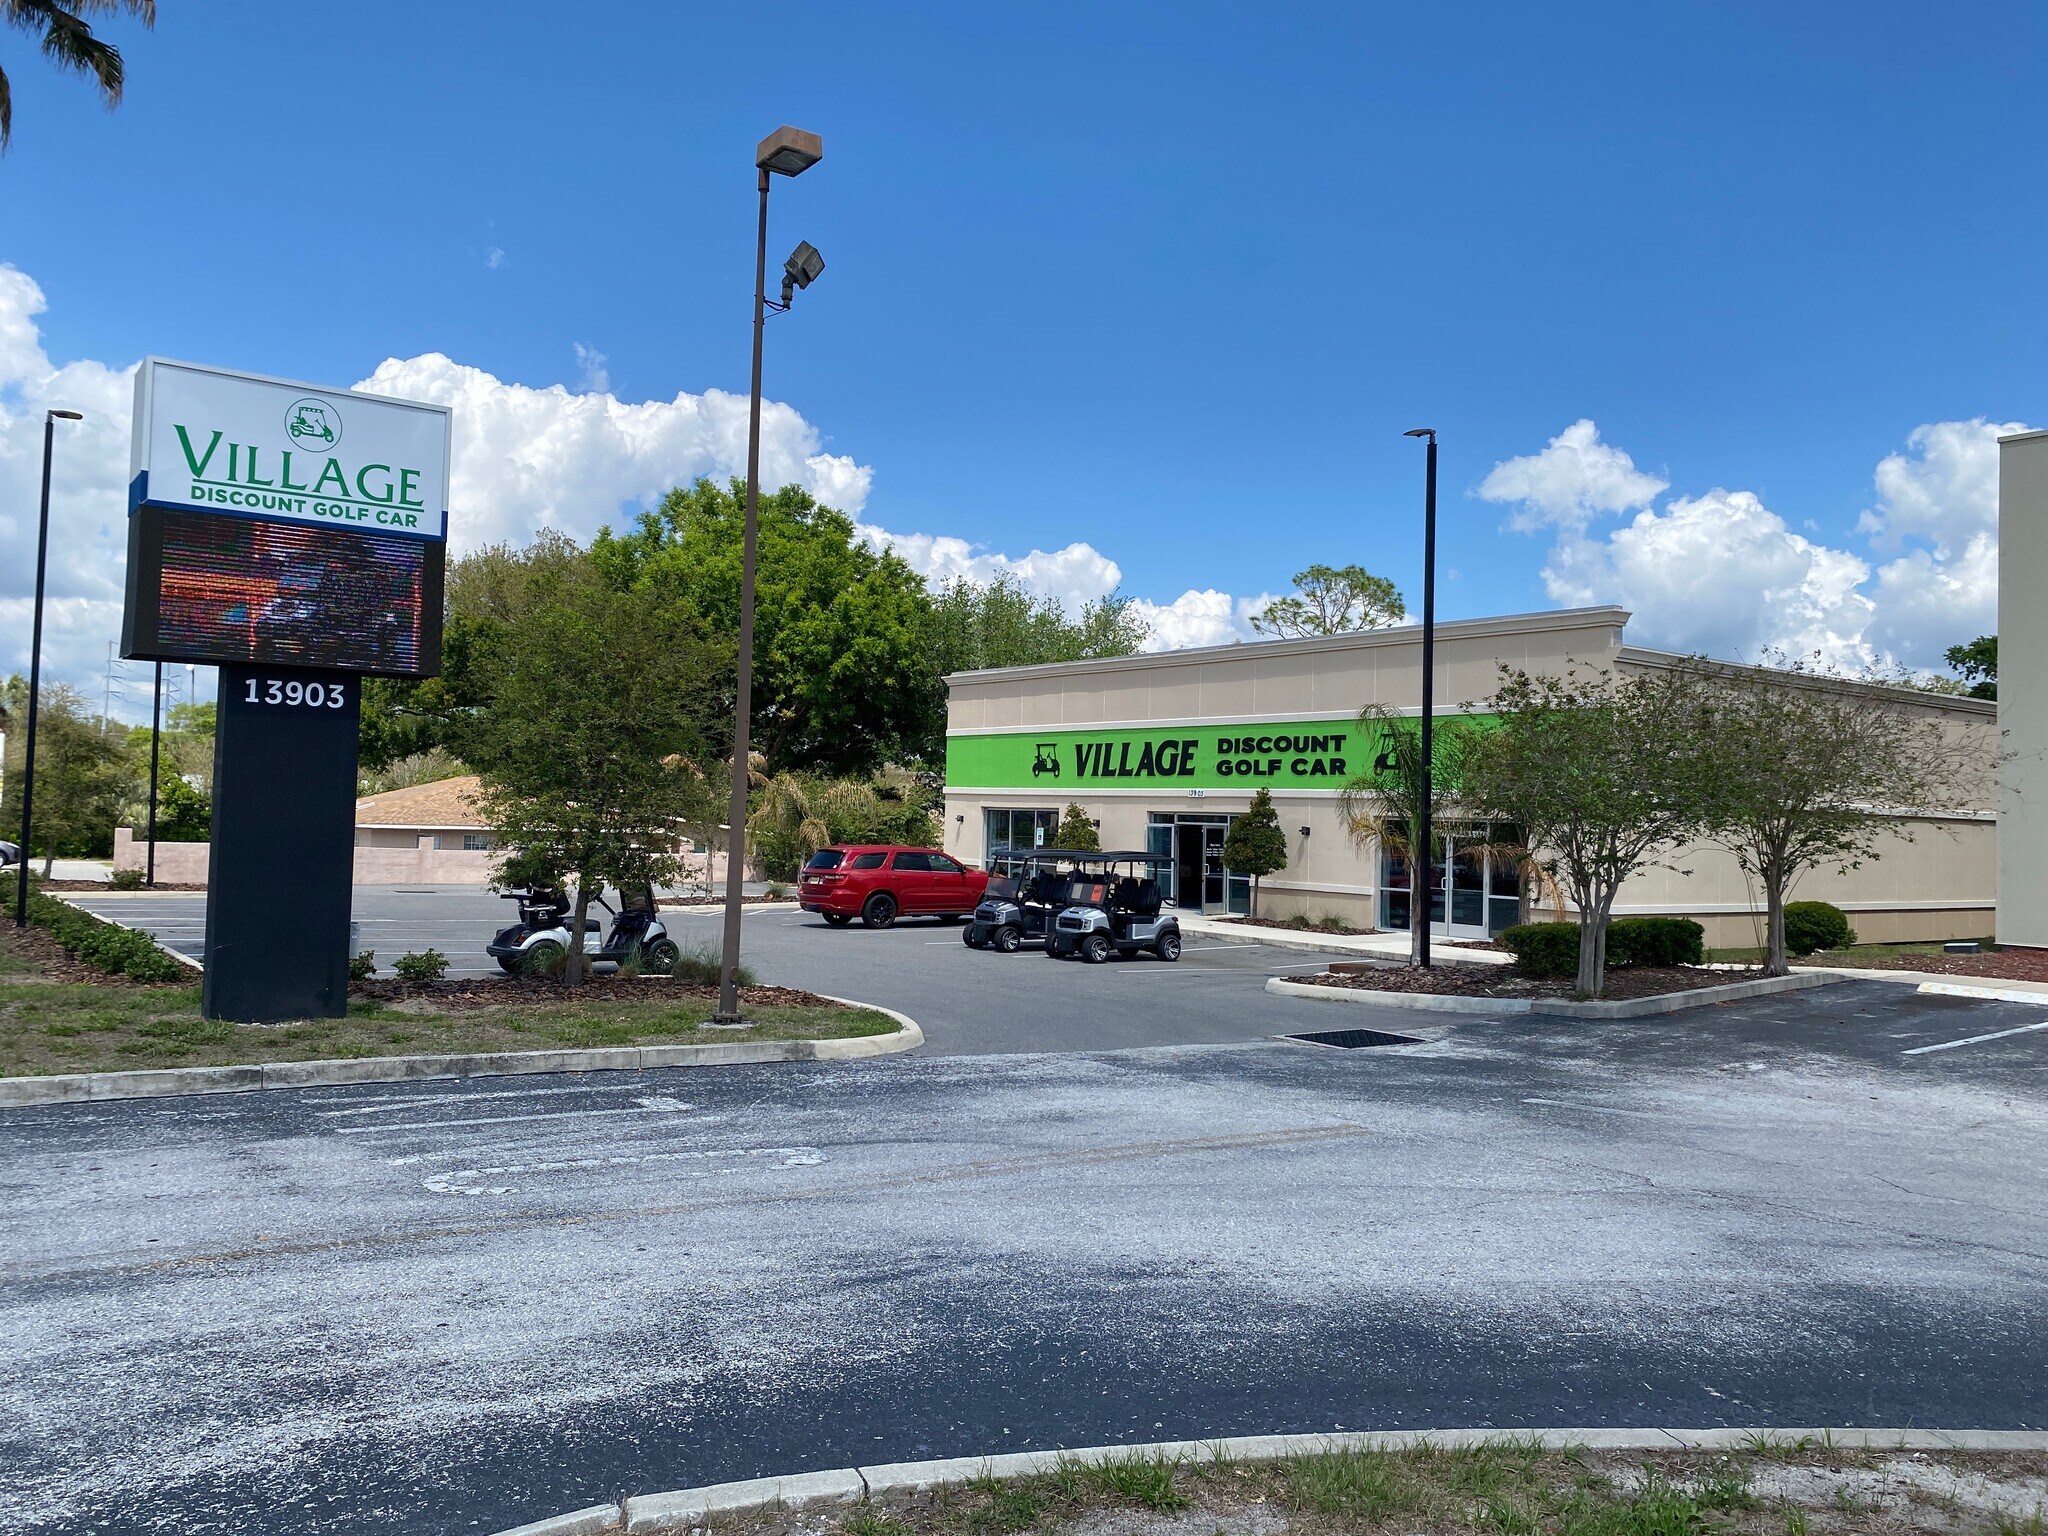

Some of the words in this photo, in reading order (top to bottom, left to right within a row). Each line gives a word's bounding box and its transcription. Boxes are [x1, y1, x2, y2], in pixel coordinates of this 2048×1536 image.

[173, 424, 425, 507] VILLAGE
[190, 485, 307, 513] DISCOUNT
[313, 502, 370, 521] GOLF
[375, 510, 418, 528] CAR
[244, 678, 345, 709] 13903
[1074, 739, 1199, 777] VILLAGE
[1217, 734, 1347, 754] DISCOUNT
[1216, 759, 1283, 776] GOLF
[1290, 758, 1347, 776] CAR
